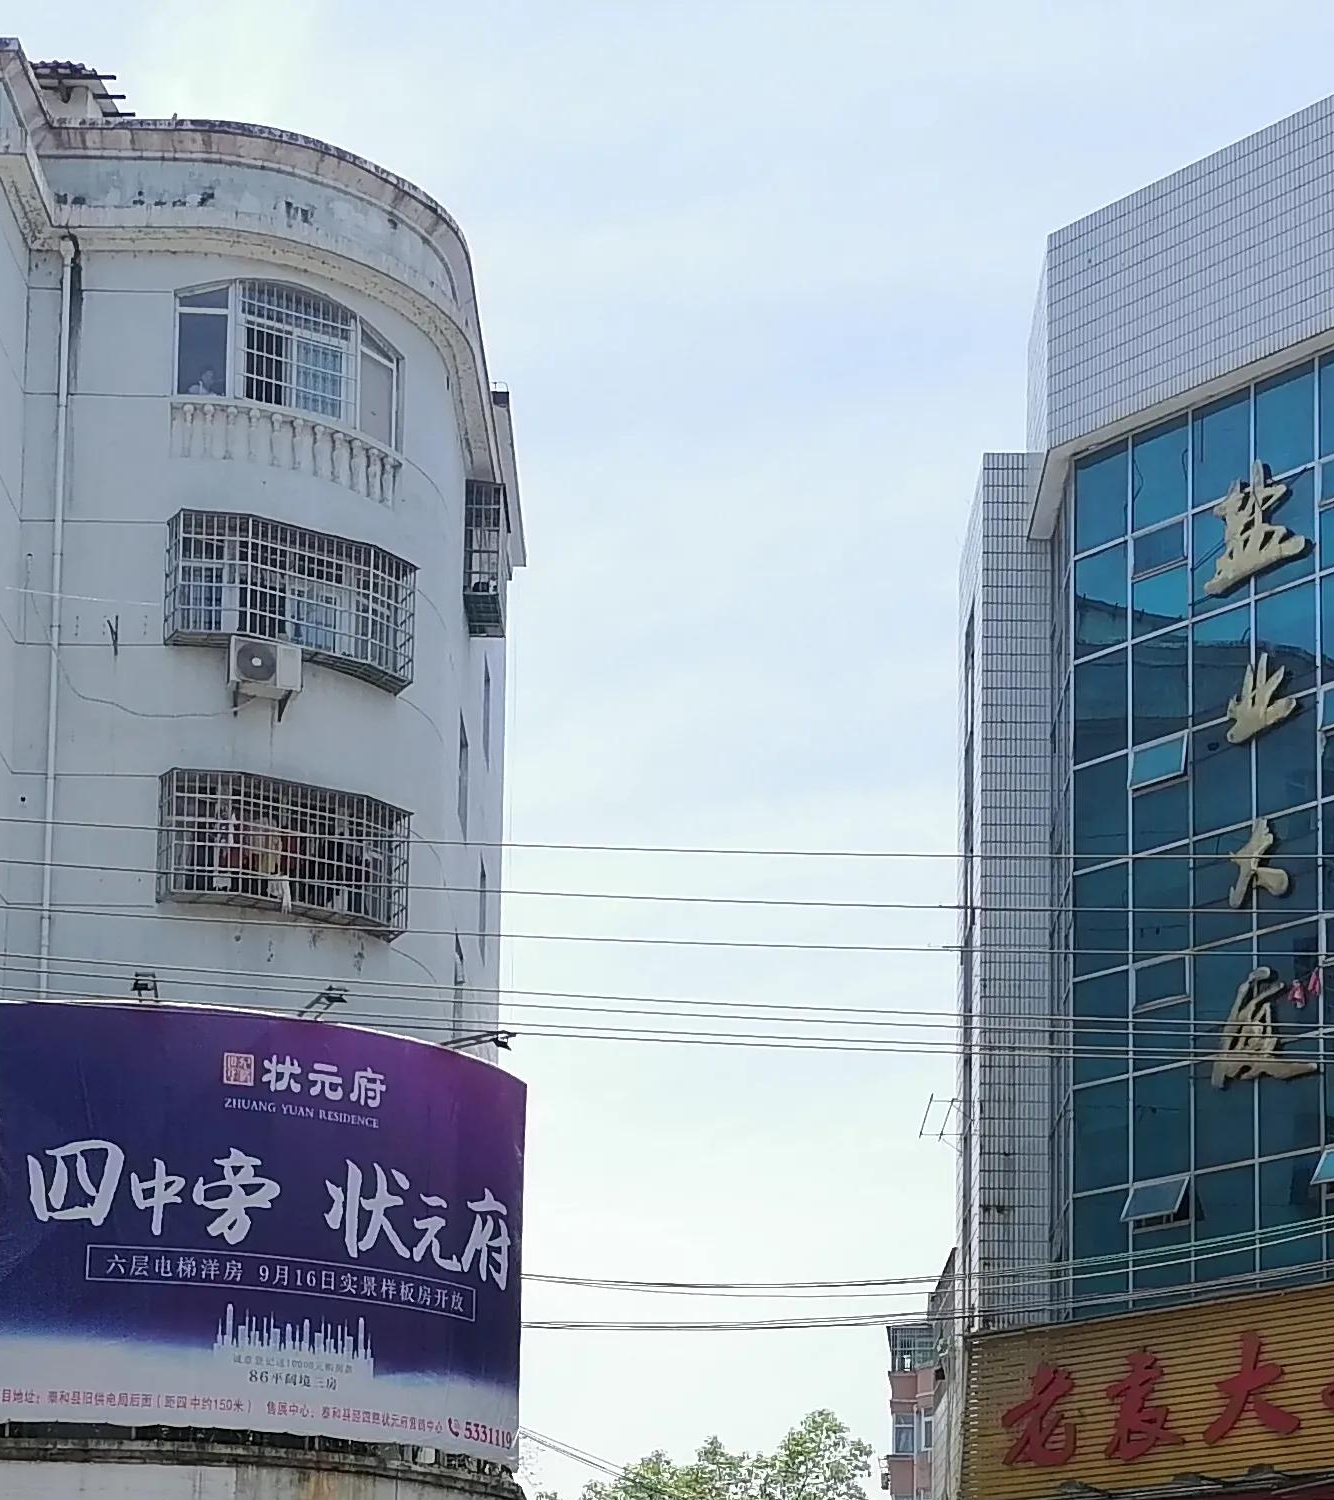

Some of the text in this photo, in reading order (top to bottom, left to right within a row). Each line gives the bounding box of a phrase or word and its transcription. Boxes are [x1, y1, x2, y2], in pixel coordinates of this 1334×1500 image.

[262, 1054, 387, 1108] 状元府
[224, 1097, 380, 1129] ZHUANG YUAN RESIDENCE
[26, 1139, 512, 1292] 四中旁 状元府
[105, 1253, 244, 1283] 六层电梯洋房
